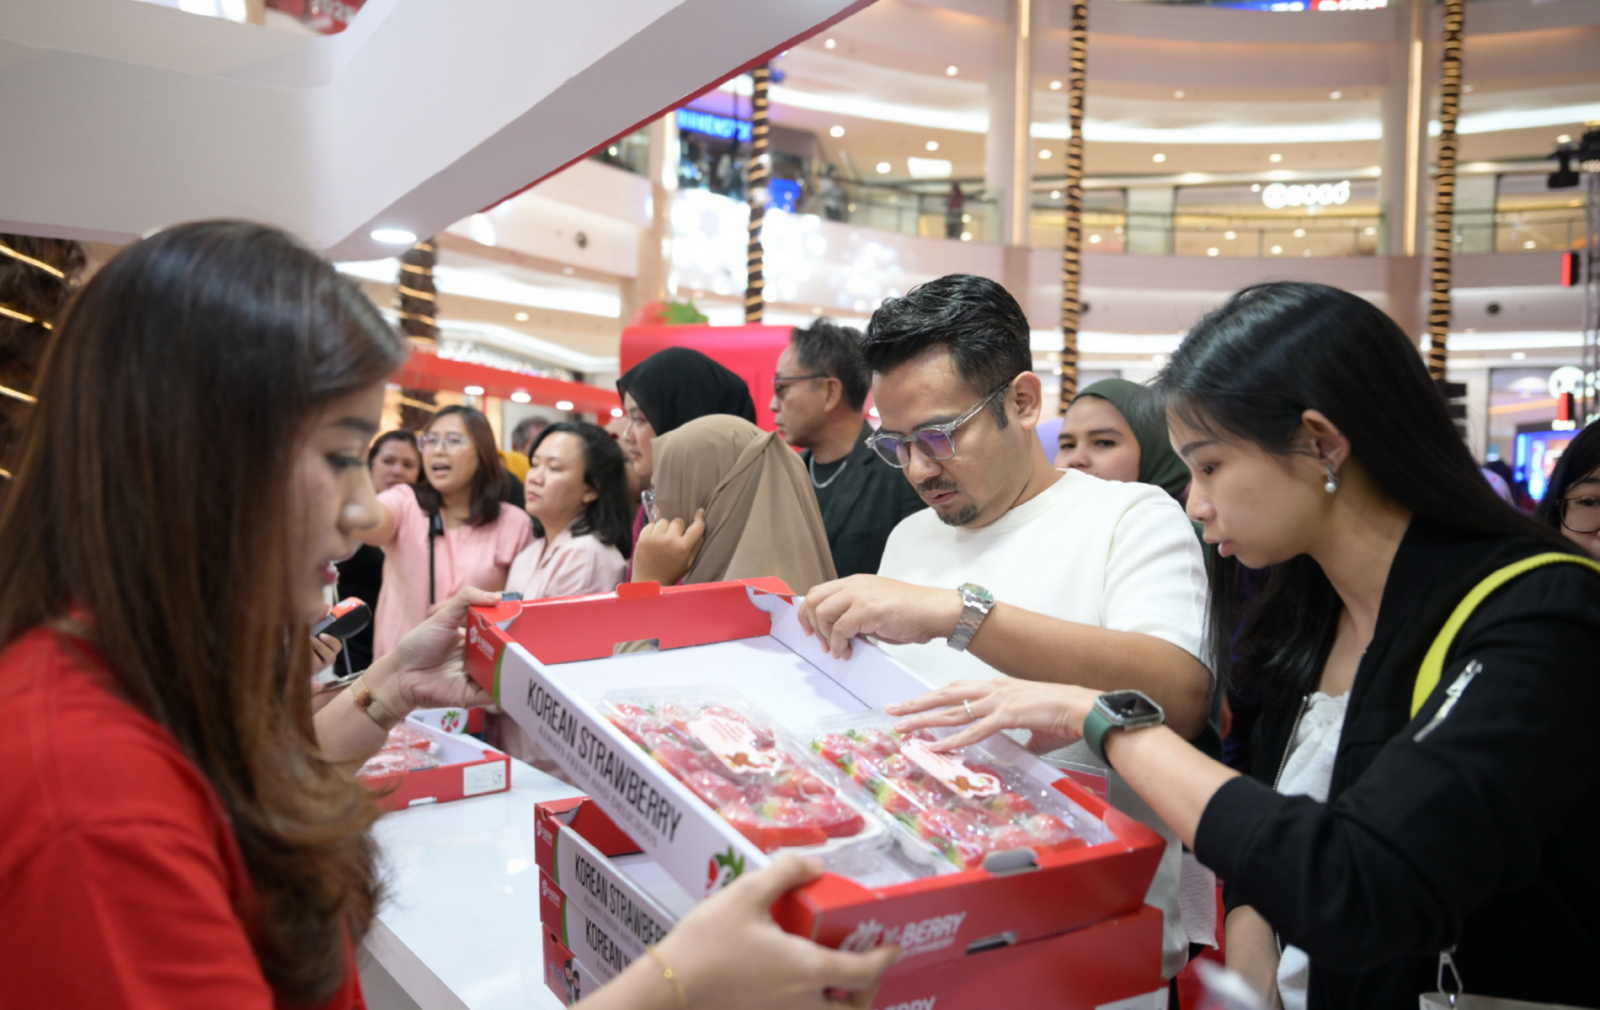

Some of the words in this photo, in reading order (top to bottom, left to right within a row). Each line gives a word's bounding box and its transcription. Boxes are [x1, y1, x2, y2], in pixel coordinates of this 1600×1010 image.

[527, 678, 578, 748] KOREAN
[579, 725, 683, 843] STRAWBERRY
[537, 725, 565, 757] ALWAYS
[566, 751, 590, 782] FRESH
[591, 774, 611, 798] AND
[611, 795, 658, 848] DELICIOUS
[575, 852, 608, 908] KOREAN
[585, 916, 622, 974] KOREAN
